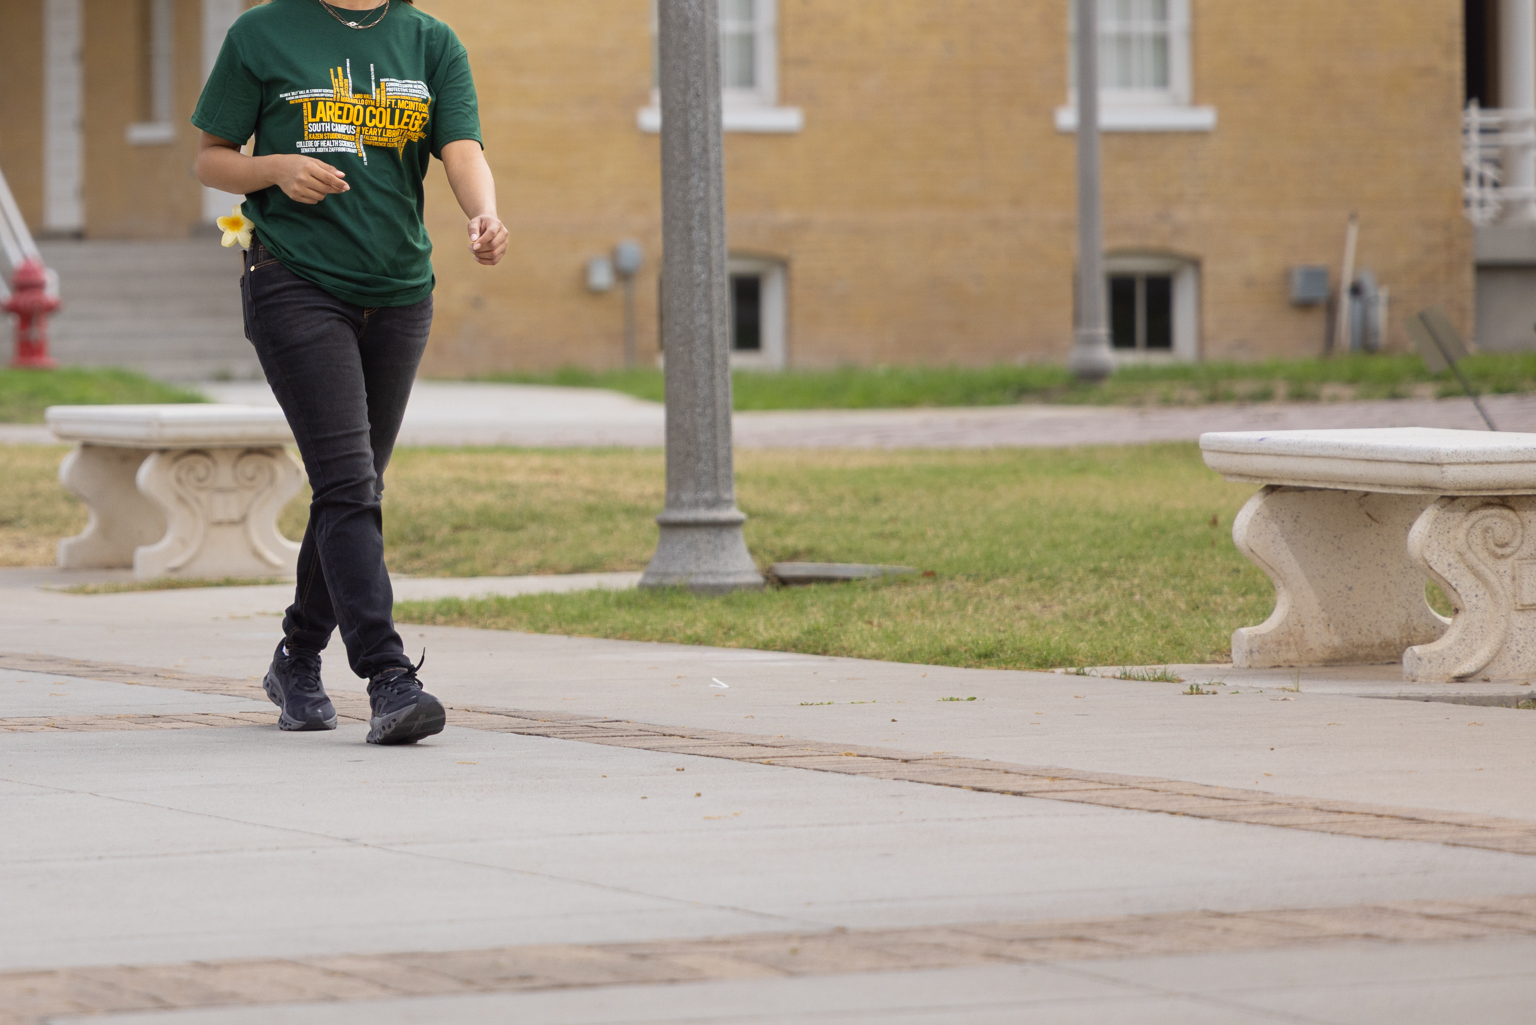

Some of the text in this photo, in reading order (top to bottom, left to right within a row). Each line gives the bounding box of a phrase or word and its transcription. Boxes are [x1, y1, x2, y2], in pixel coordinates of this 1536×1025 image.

[386, 99, 397, 108] FT.
[307, 102, 363, 125] LAREDO
[365, 106, 428, 131] COLLEGE
[308, 122, 356, 134] SOUTH CAMPUS
[361, 127, 382, 136] YEARY
